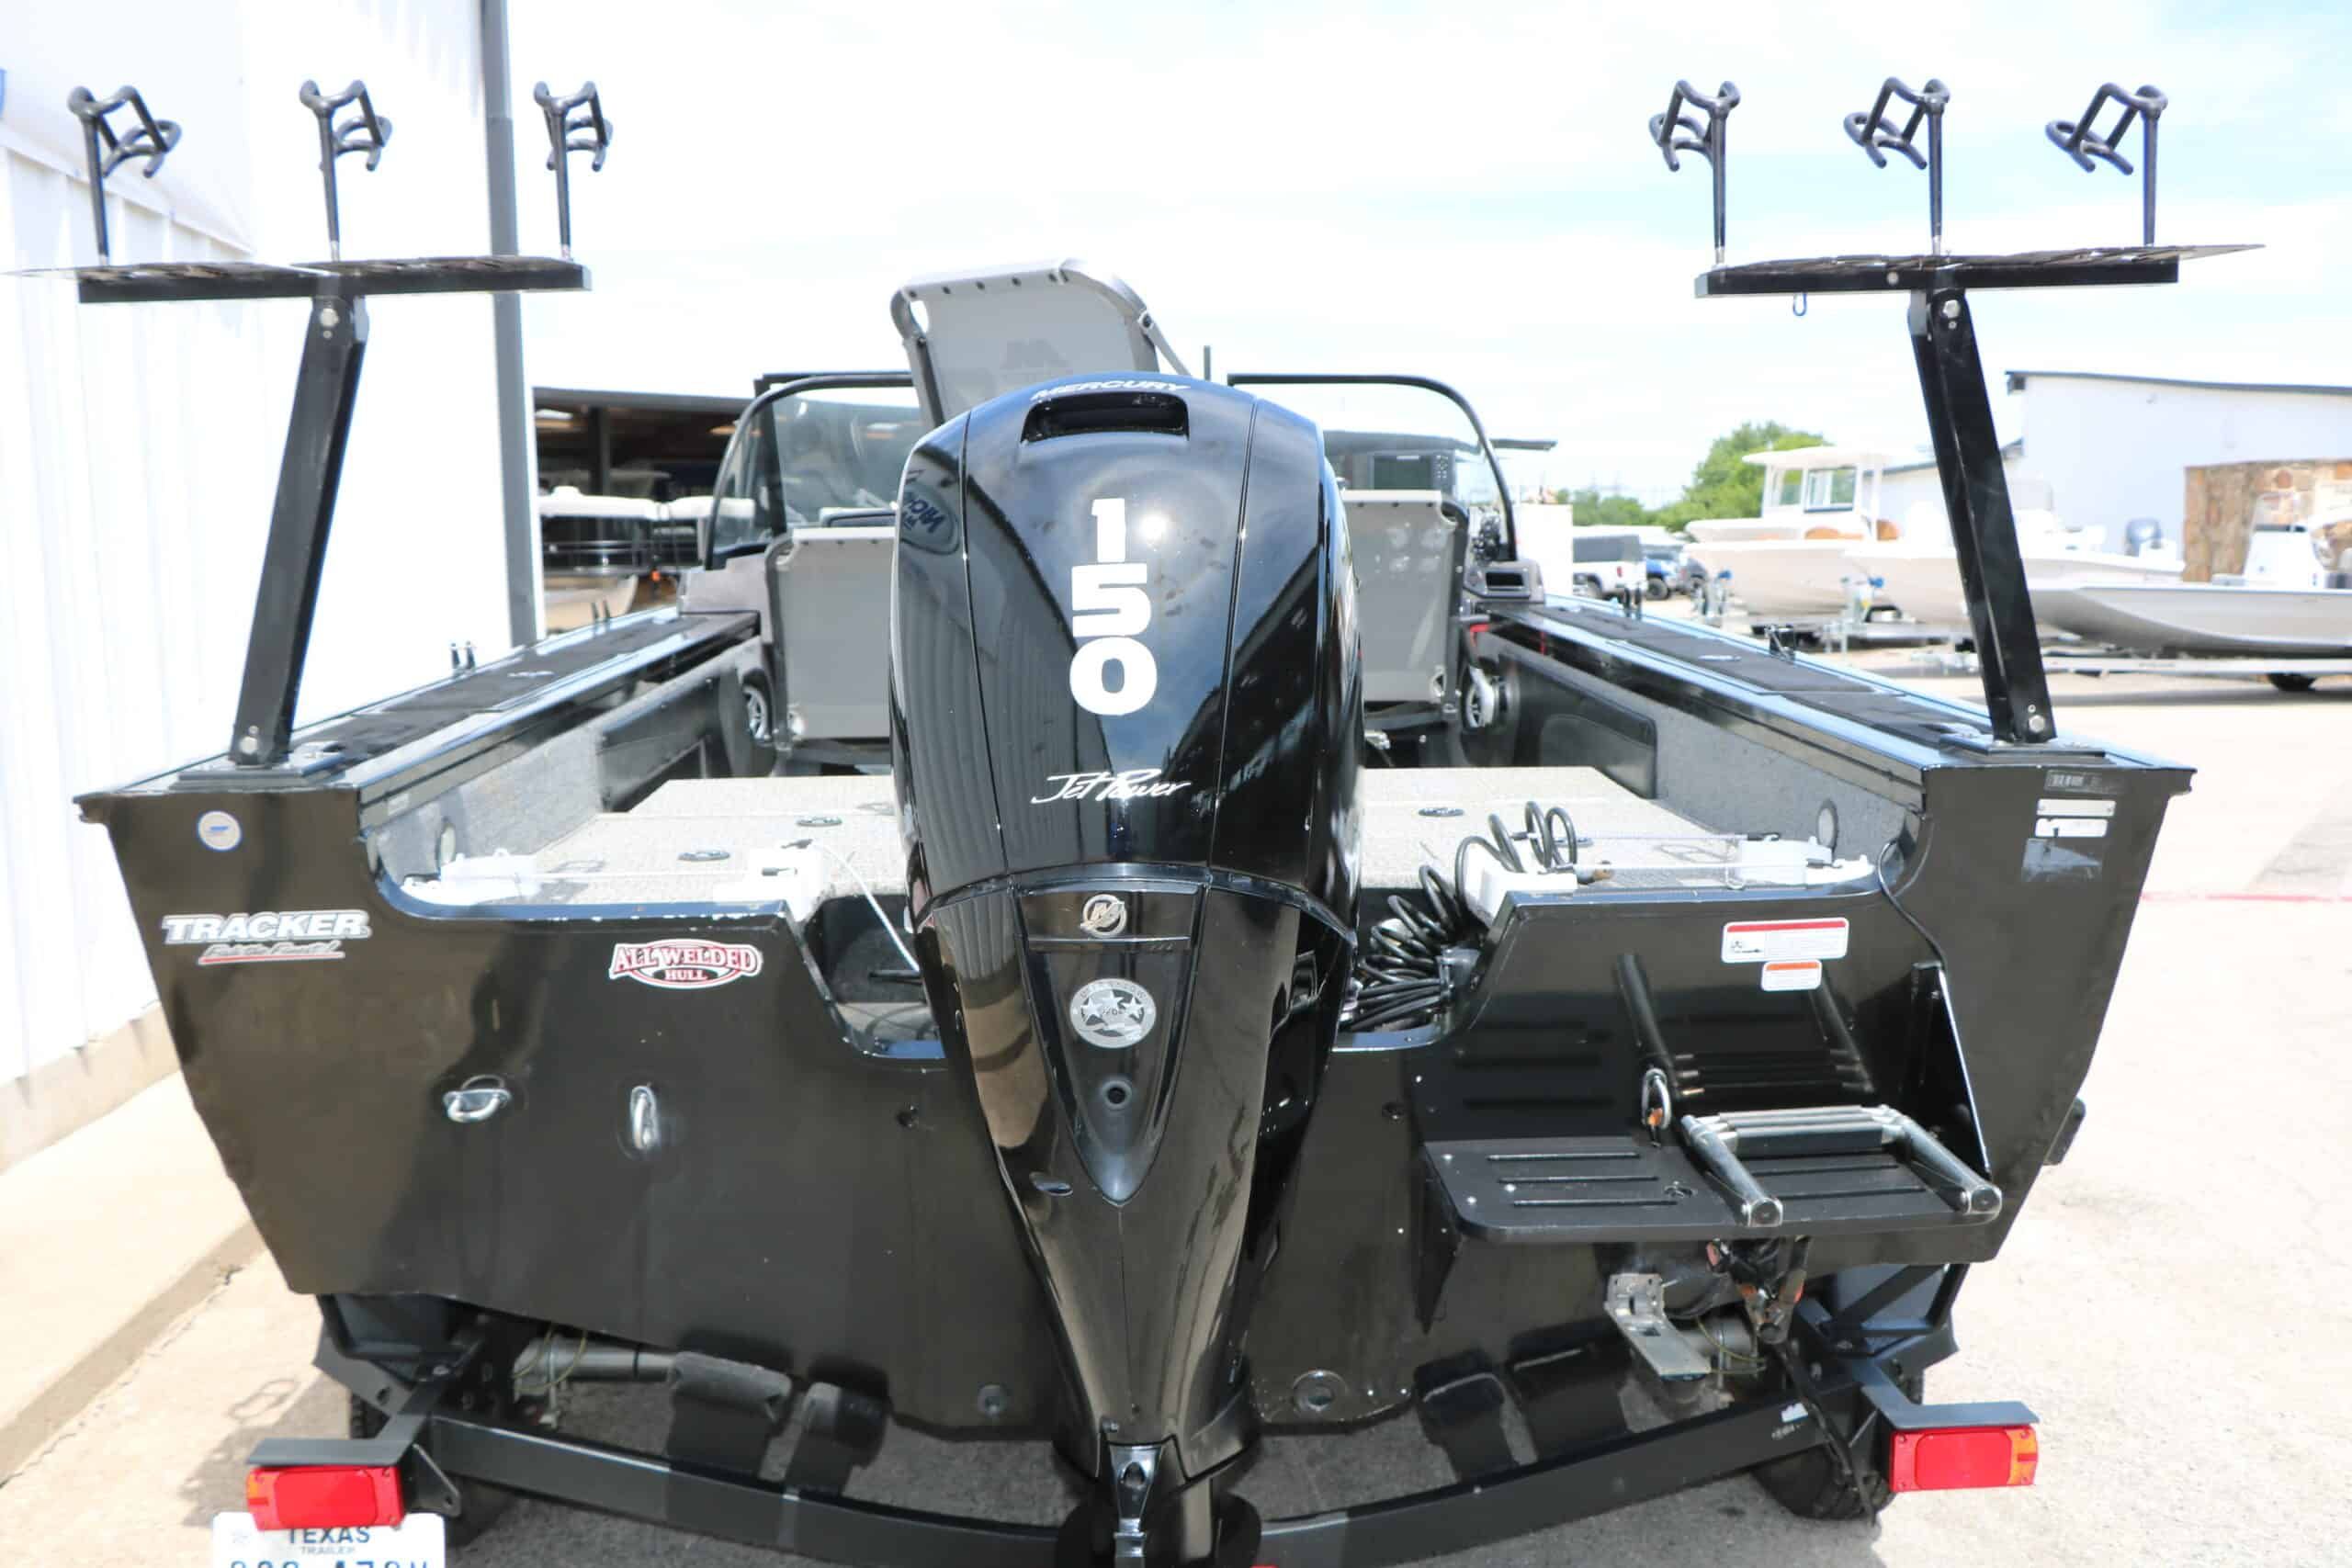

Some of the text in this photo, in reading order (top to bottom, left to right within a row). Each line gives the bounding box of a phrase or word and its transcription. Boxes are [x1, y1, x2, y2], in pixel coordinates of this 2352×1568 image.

[1030, 380, 1191, 402] MERCURY
[1069, 498, 1158, 716] 150
[1031, 772, 1112, 804] Jet
[164, 912, 363, 942] TRACKER
[613, 946, 756, 974] ALL WELDED
[664, 969, 707, 980] HULL
[287, 1527, 370, 1544] TEXAS
